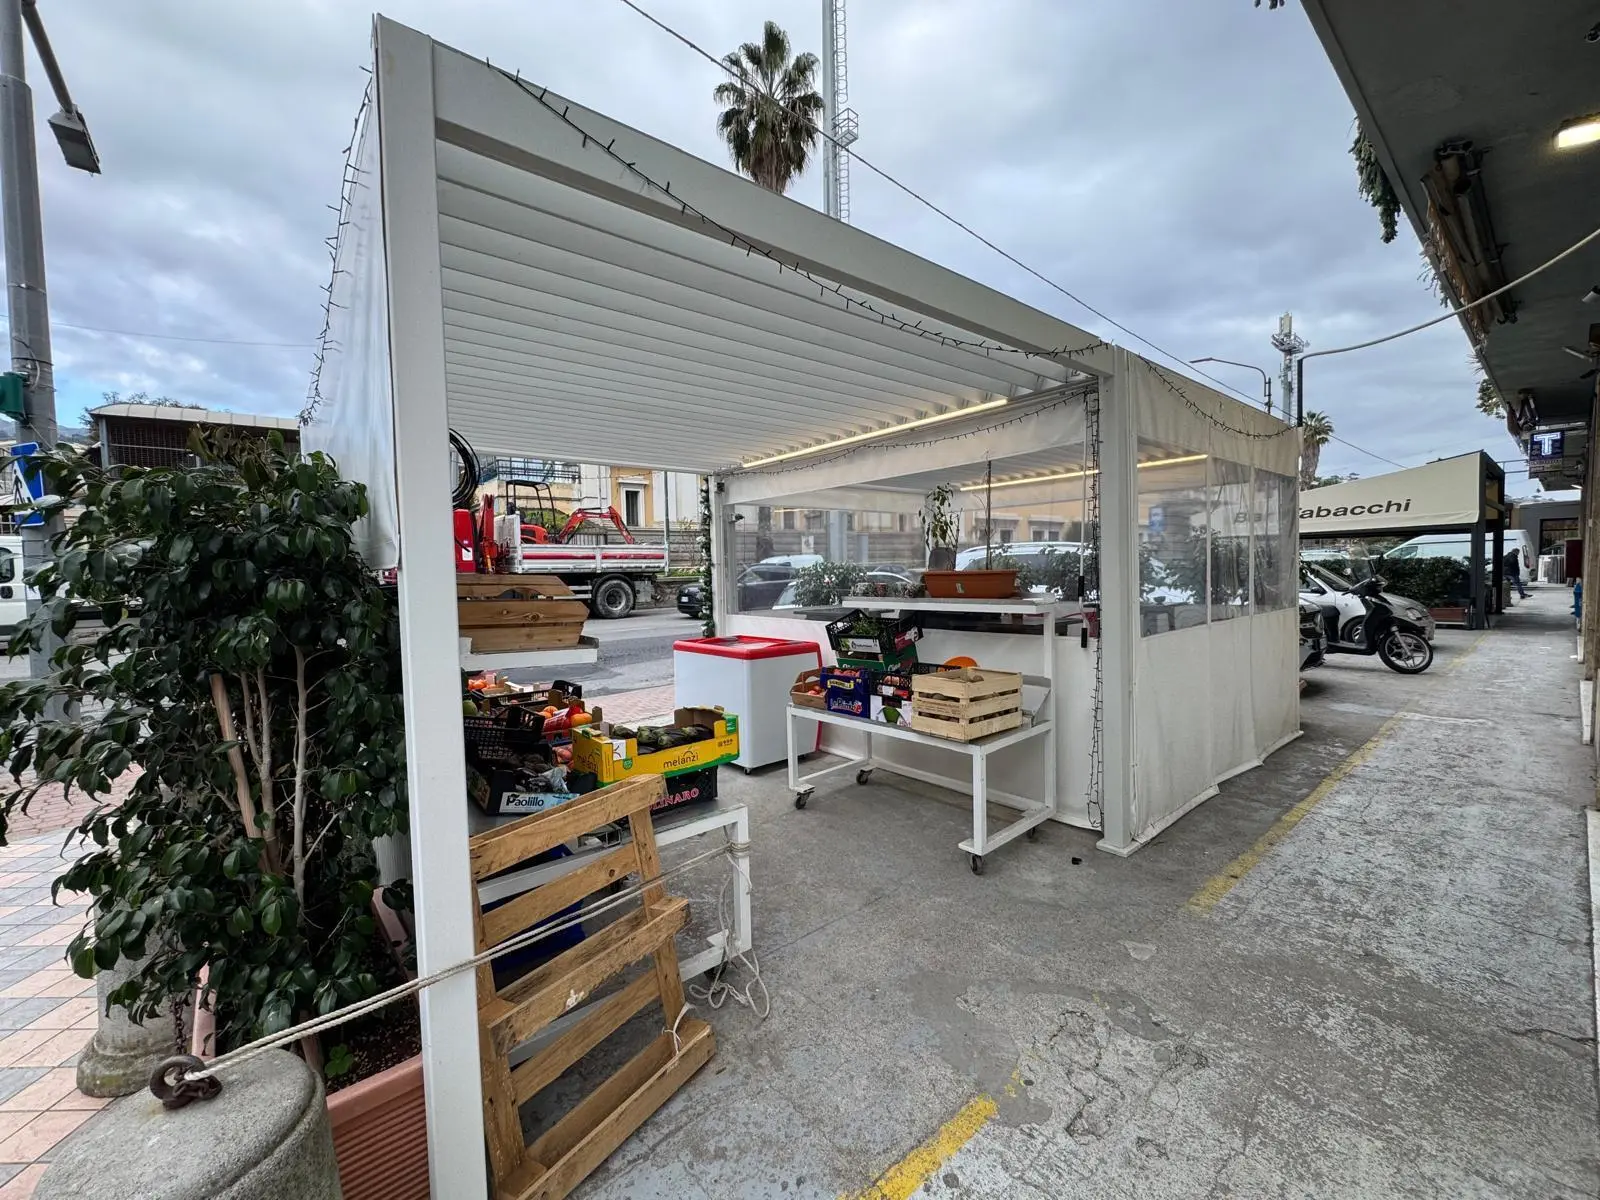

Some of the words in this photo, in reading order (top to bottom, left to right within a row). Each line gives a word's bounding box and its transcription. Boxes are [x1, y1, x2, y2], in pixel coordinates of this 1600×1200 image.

[1533, 432, 1561, 455] T
[1298, 499, 1411, 519] abacchi
[663, 751, 699, 769] melanzi
[506, 794, 544, 807] Paolillo
